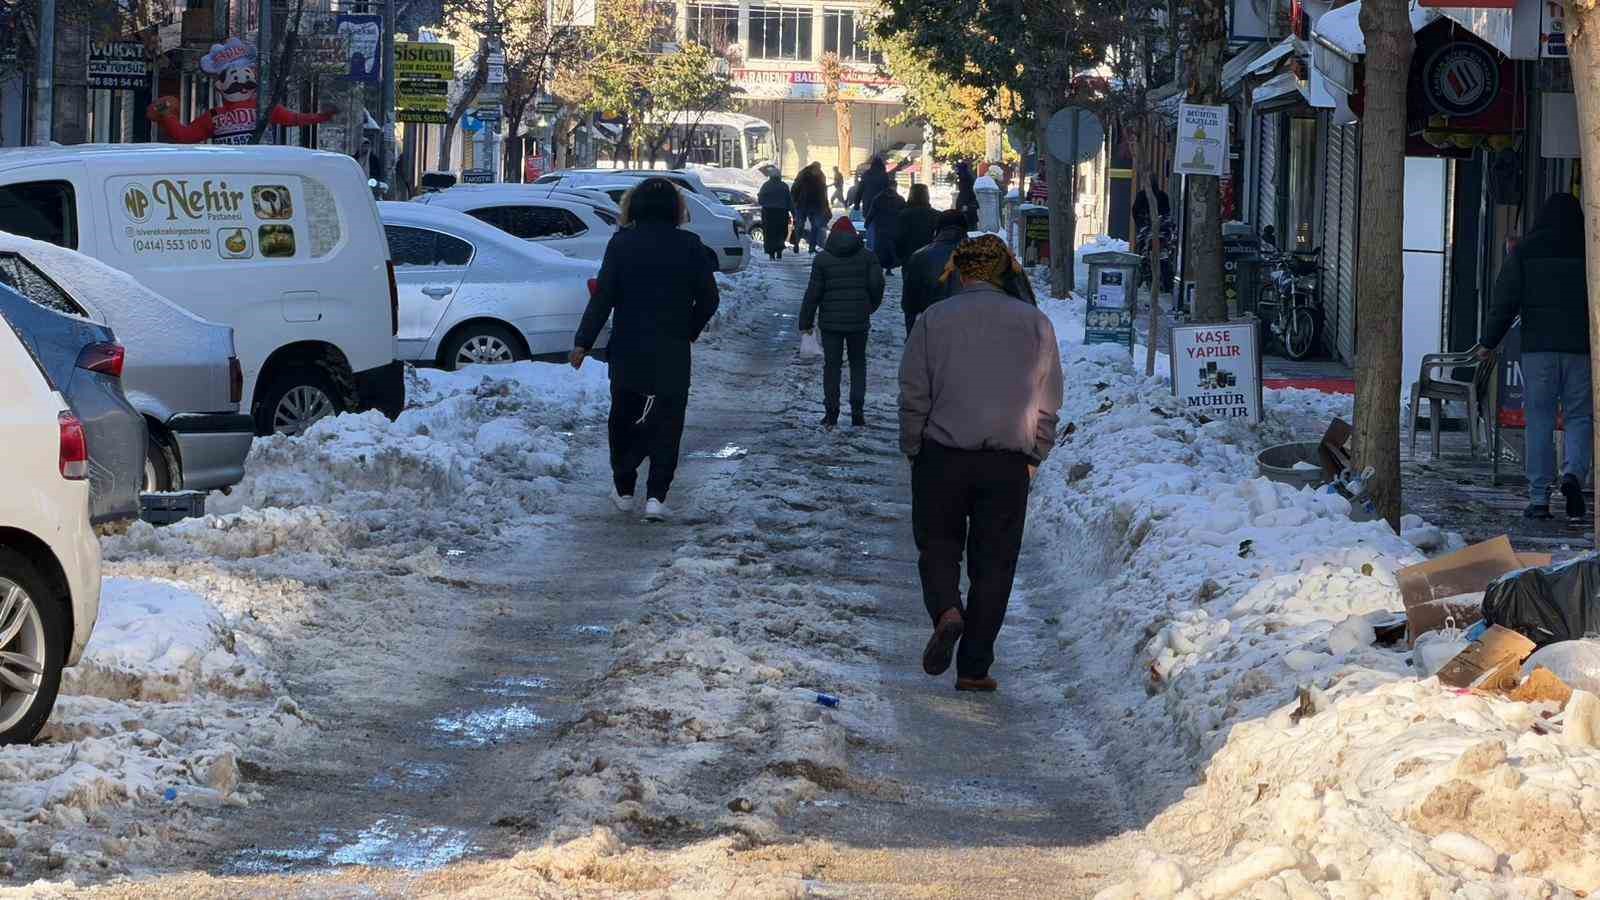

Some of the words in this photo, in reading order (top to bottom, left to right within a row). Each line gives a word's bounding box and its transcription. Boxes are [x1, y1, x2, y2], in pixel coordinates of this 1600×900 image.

[152, 179, 244, 220] Nehir
[133, 238, 164, 253] (0414)
[166, 240, 185, 250] 553
[187, 240, 200, 251] 10
[201, 239, 212, 251] 10
[1195, 331, 1231, 344] KAŞE
[1186, 345, 1241, 358] YAPILIR
[1187, 391, 1245, 407] MÜHÜR
